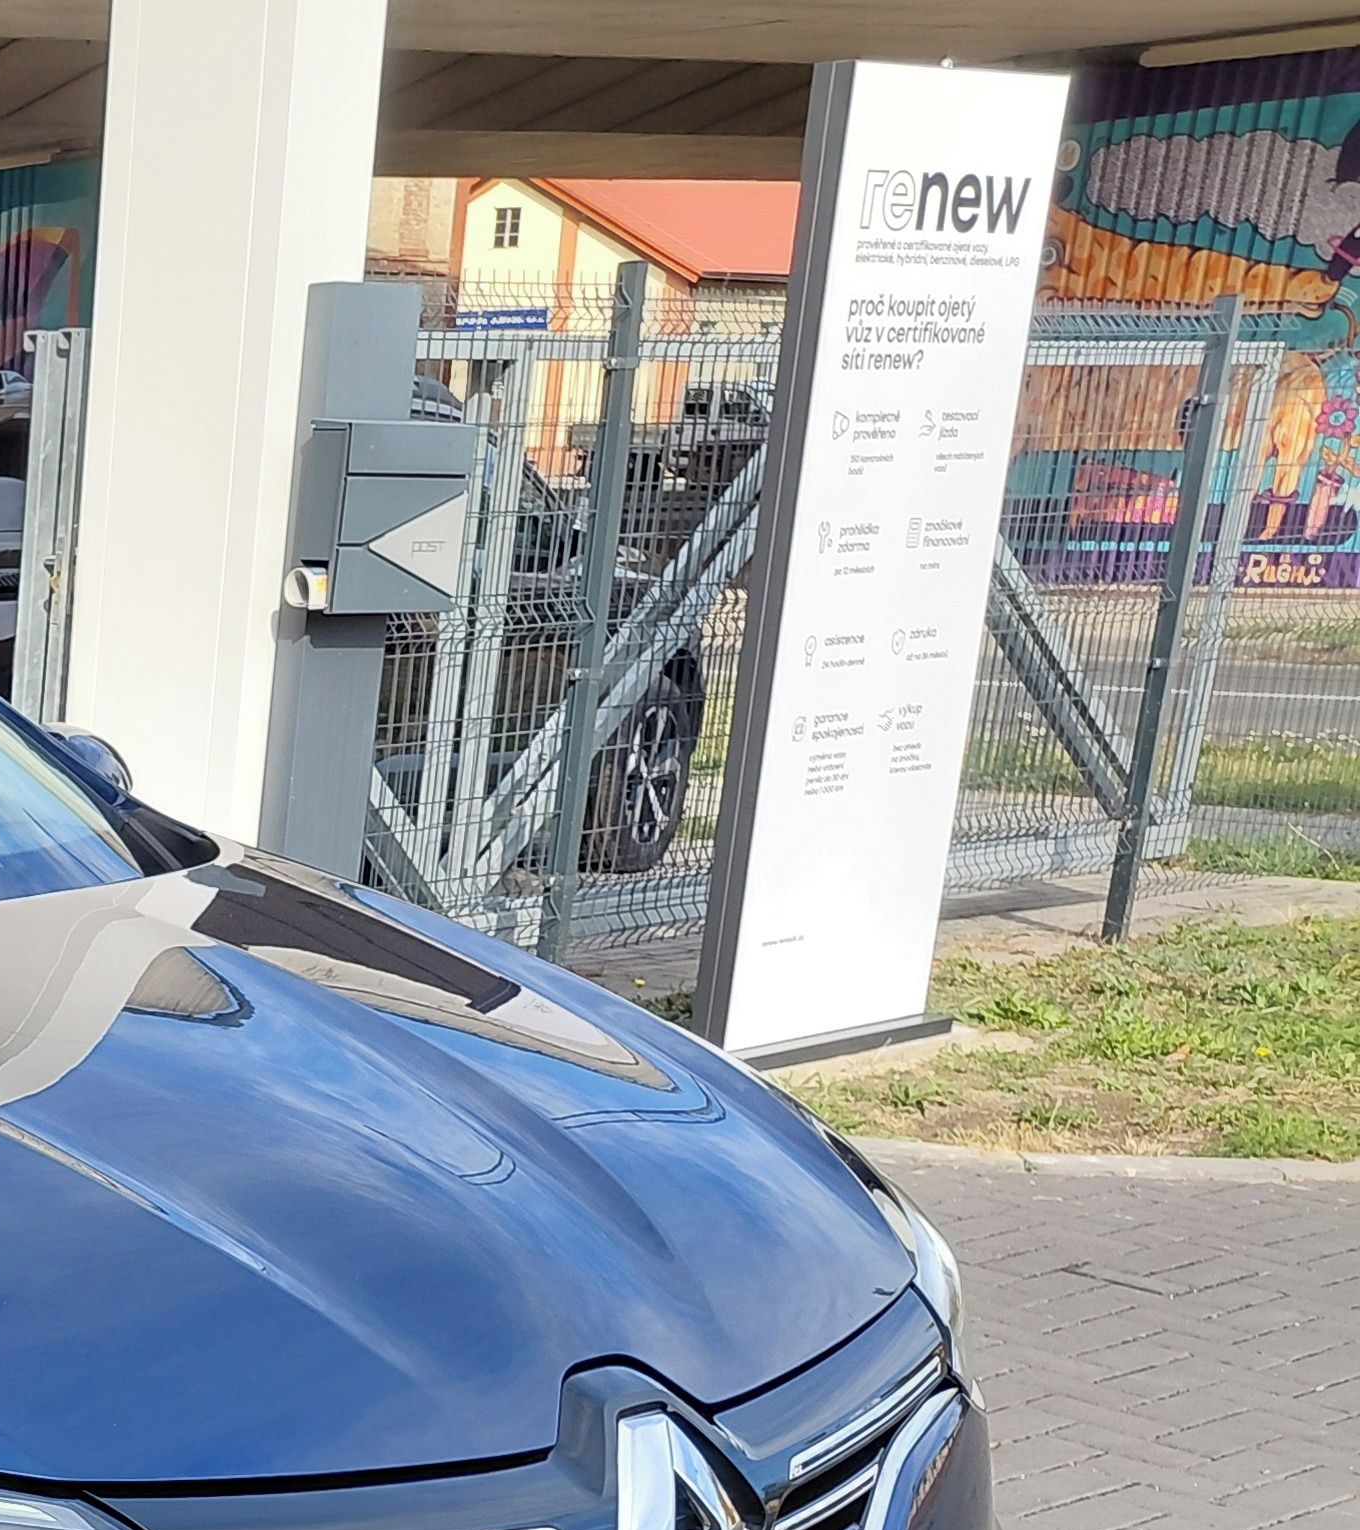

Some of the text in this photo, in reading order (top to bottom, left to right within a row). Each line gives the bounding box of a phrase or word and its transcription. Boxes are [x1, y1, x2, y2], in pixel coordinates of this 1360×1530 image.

[859, 169, 1031, 234] renew
[848, 293, 976, 323] proč koupit ojetý
[845, 319, 986, 344] vůz v certifikované
[841, 347, 924, 370] síti renew?
